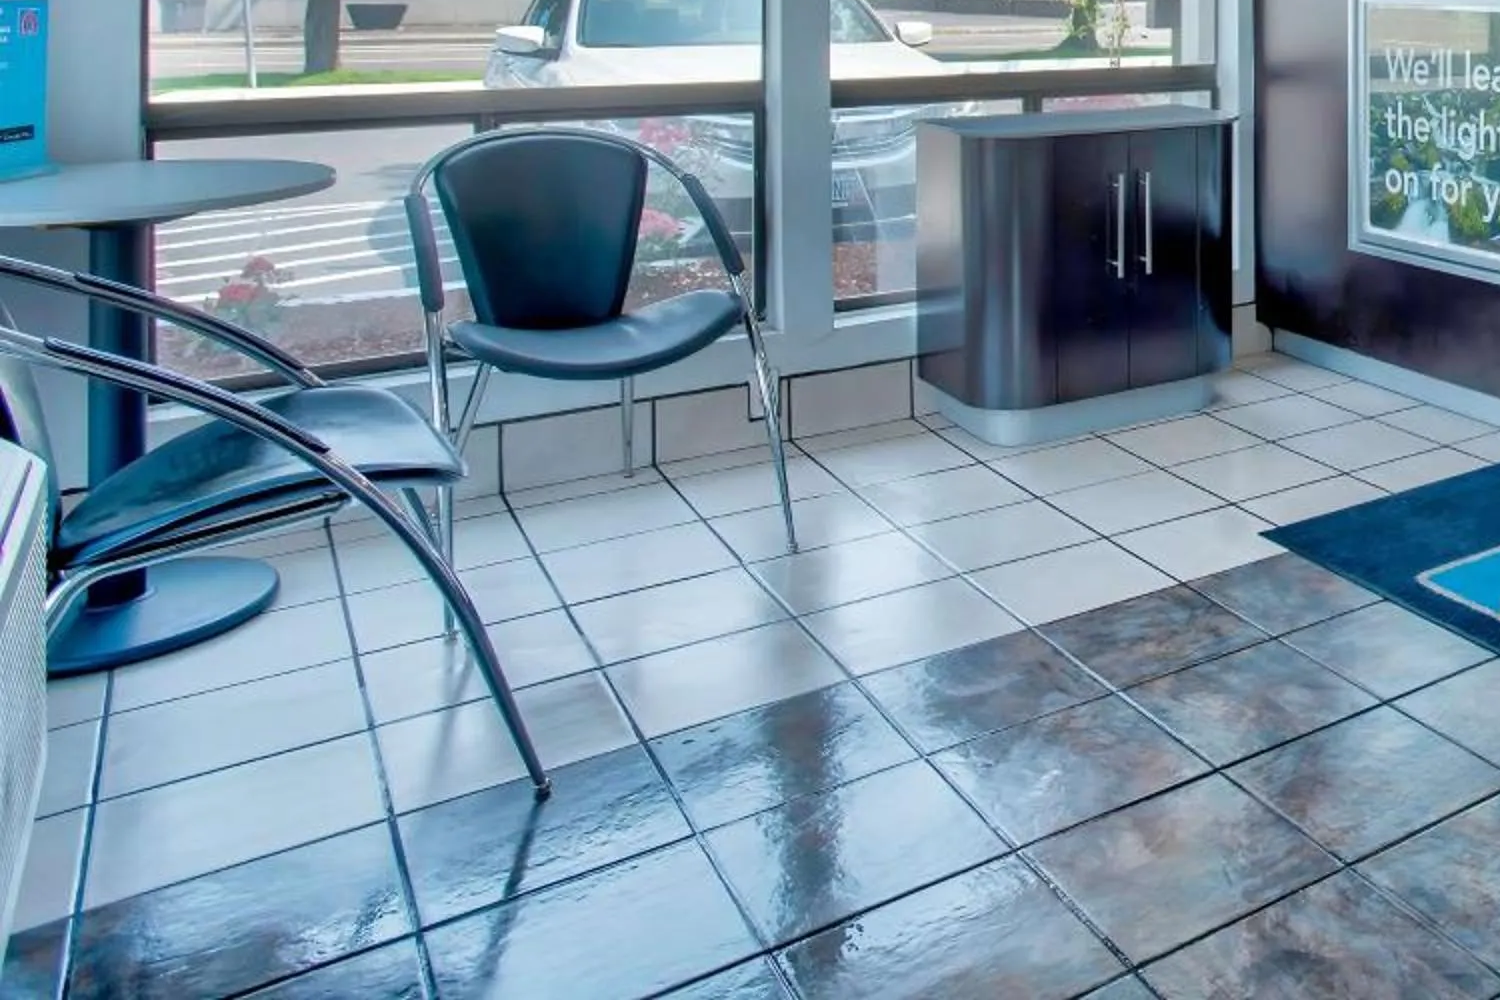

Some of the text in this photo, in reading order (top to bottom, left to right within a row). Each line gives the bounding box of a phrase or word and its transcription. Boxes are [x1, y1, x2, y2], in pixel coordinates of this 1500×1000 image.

[1384, 101, 1430, 143] the
[1385, 168, 1419, 198] on
[1430, 162, 1472, 207] for
